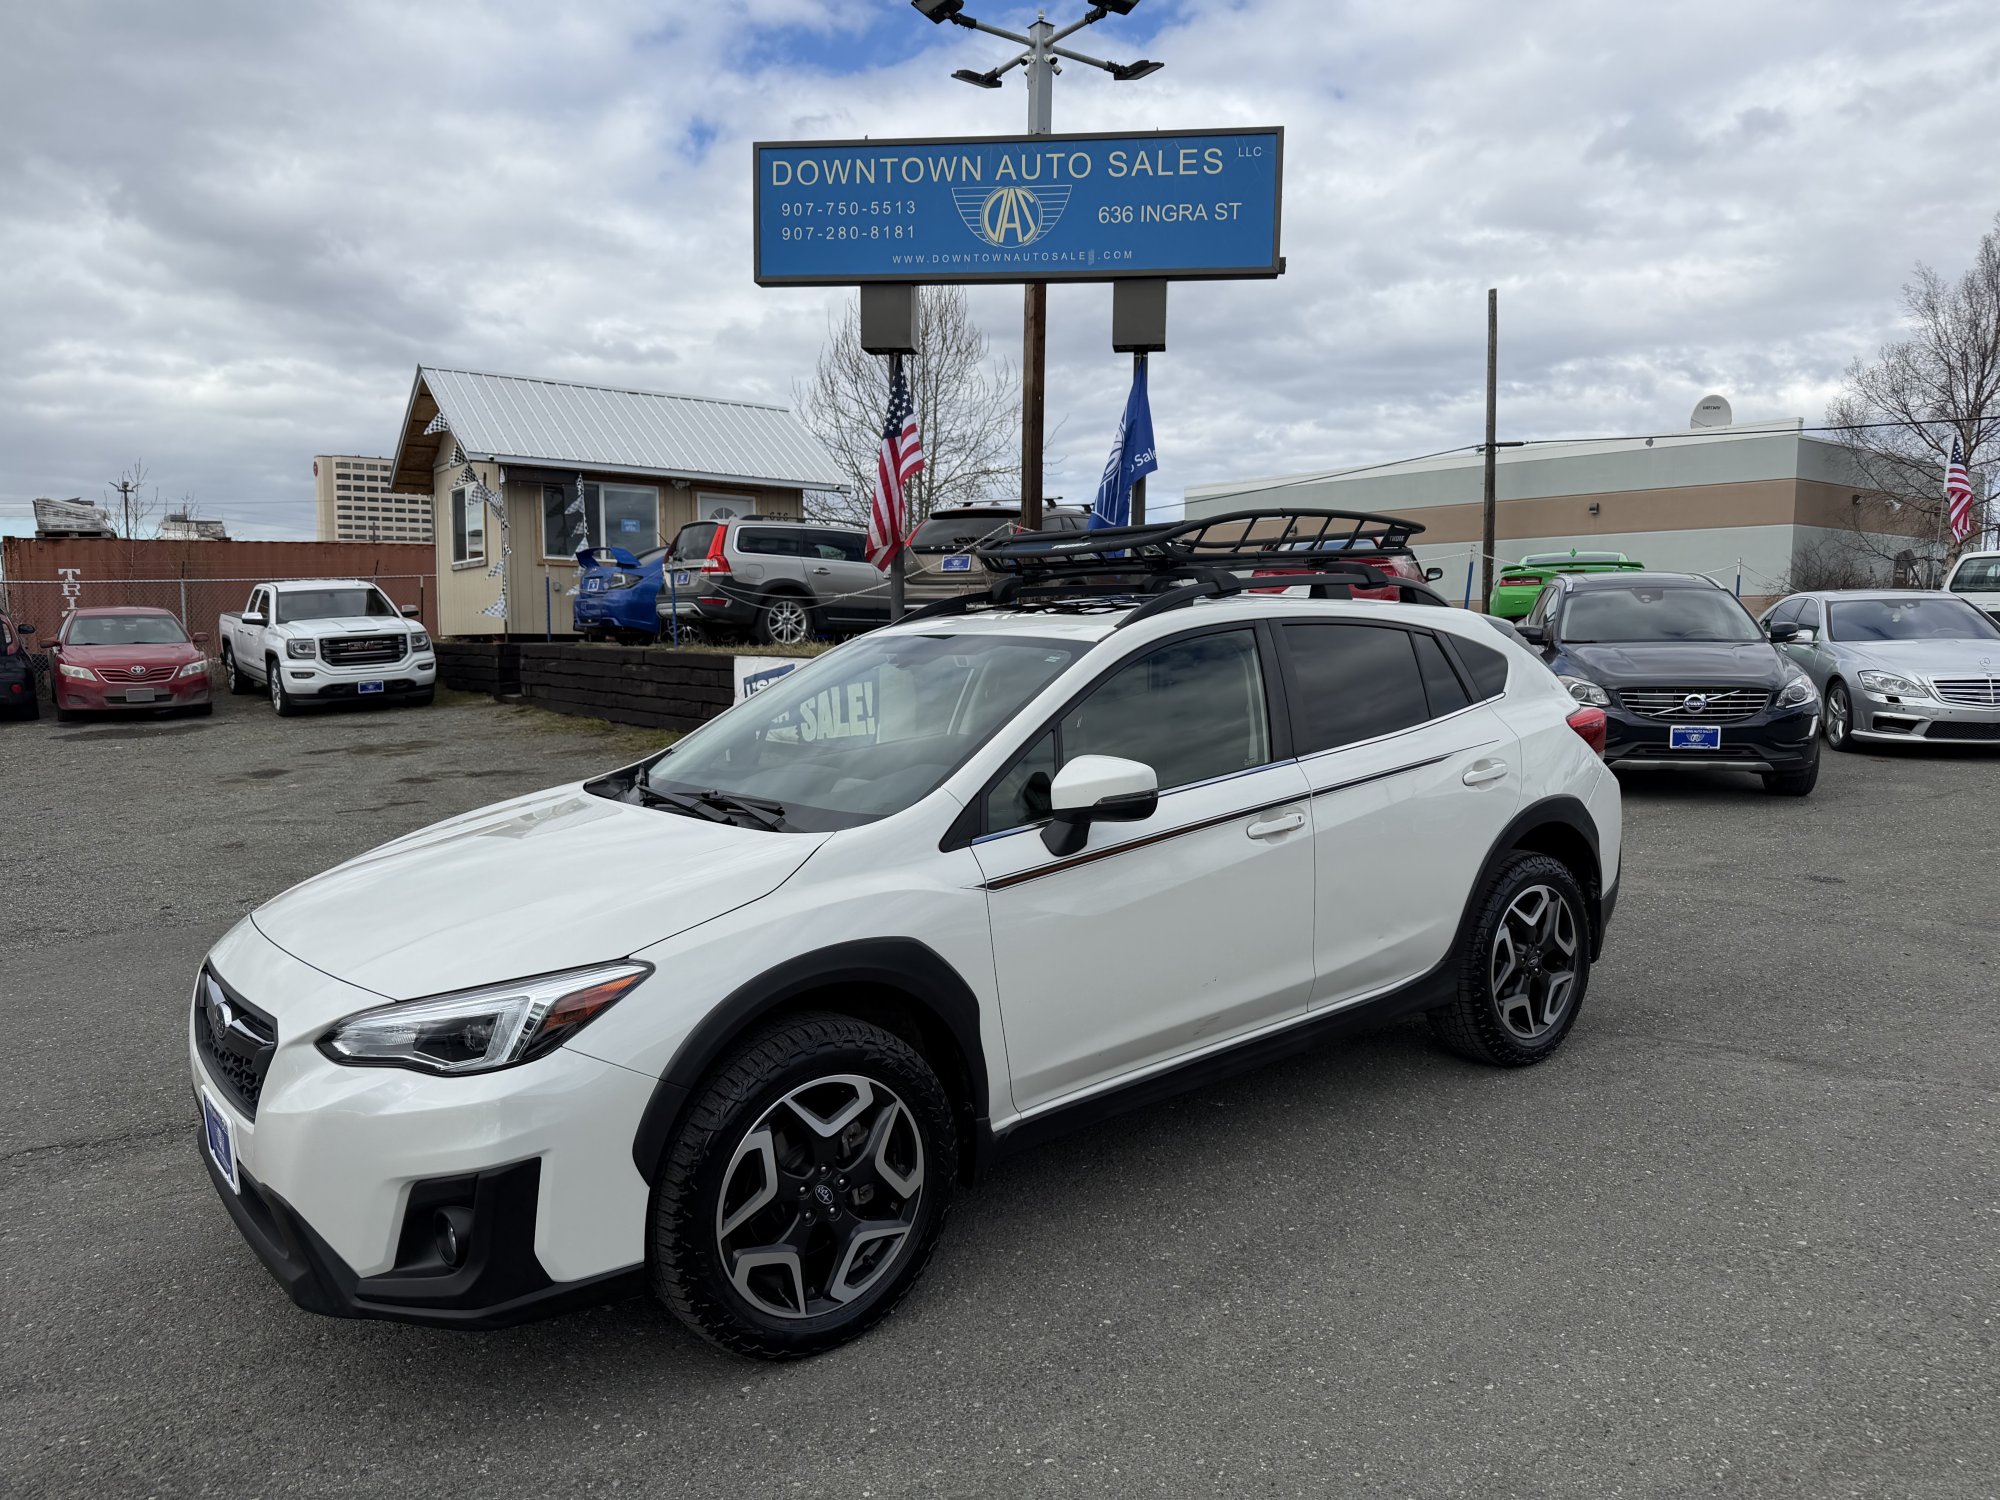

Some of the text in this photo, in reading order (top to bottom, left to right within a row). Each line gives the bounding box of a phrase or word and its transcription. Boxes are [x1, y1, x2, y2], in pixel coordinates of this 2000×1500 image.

[1238, 146, 1262, 158] LLC
[772, 147, 1224, 186] DOWNTOWN AUTO SALES
[781, 200, 916, 217] 907-750-5513
[1098, 202, 1243, 224] 636 INGRA ST
[781, 225, 914, 241] 907-280-8181
[892, 250, 1133, 265] WWW.DOWNTOWNAUTOSALE.COM
[347, 640, 384, 651] GMC
[800, 681, 876, 743] SALE!
